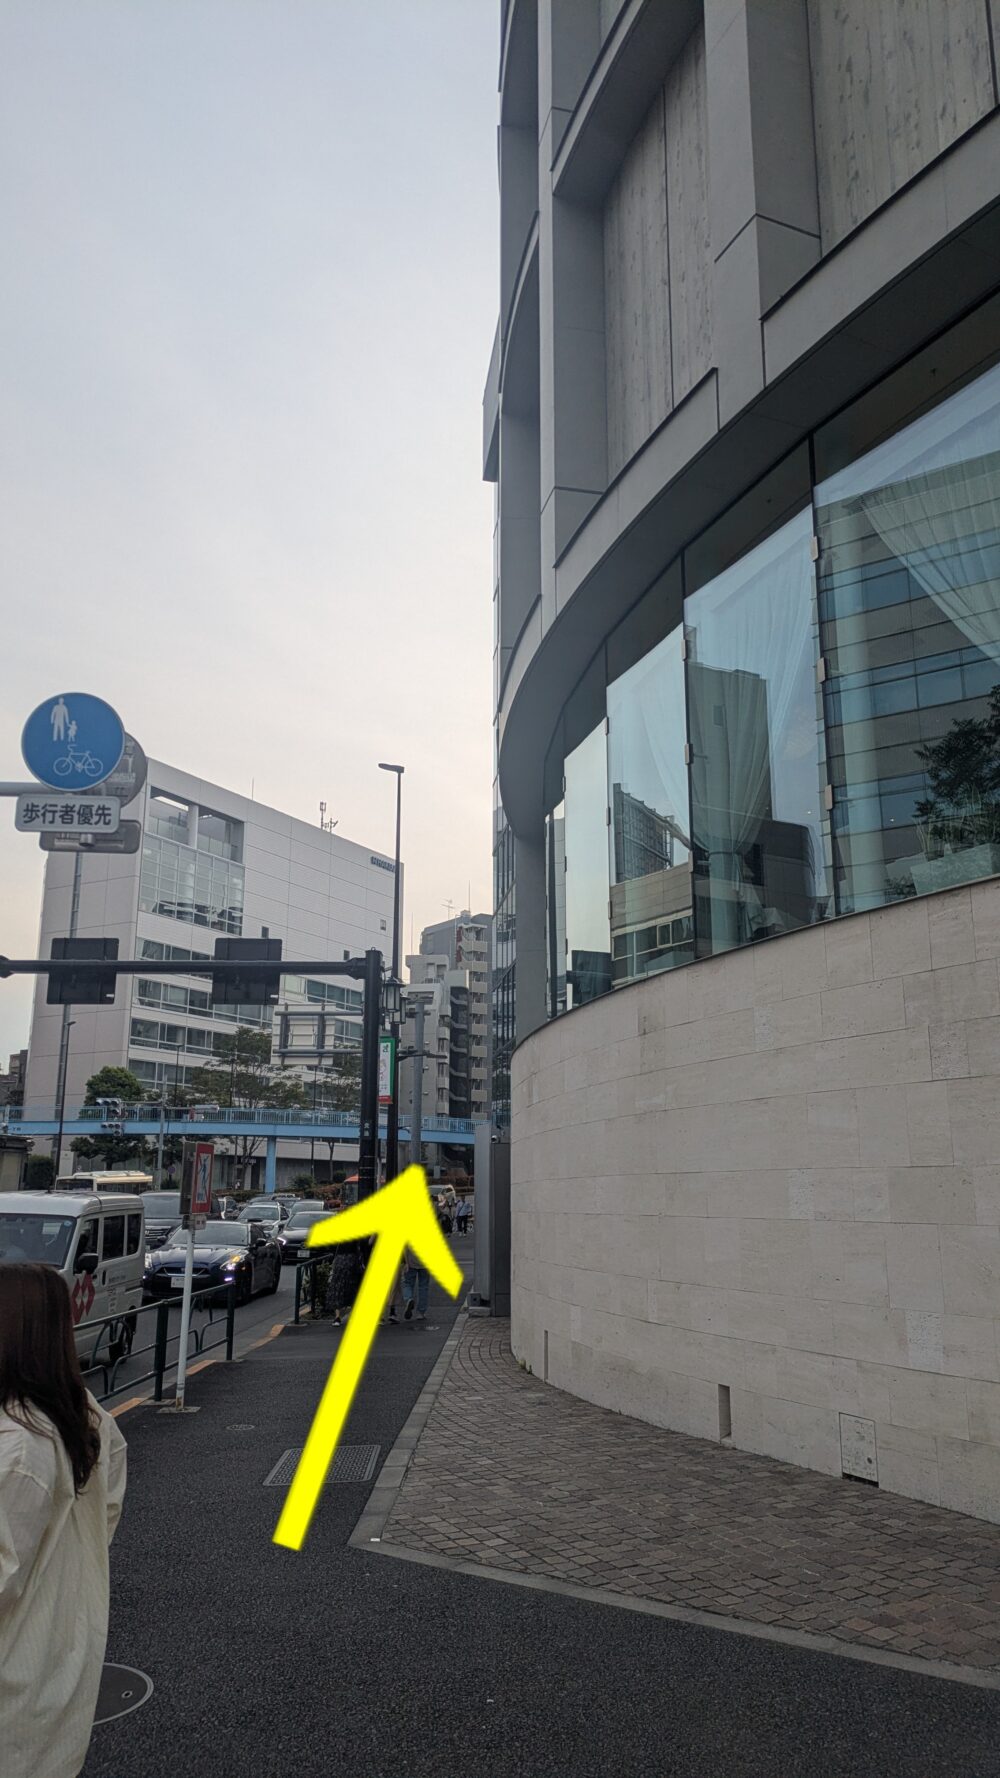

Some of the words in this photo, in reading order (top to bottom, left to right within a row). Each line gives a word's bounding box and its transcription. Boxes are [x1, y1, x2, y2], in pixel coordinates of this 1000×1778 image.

[23, 802, 112, 826] 歩行者優先
